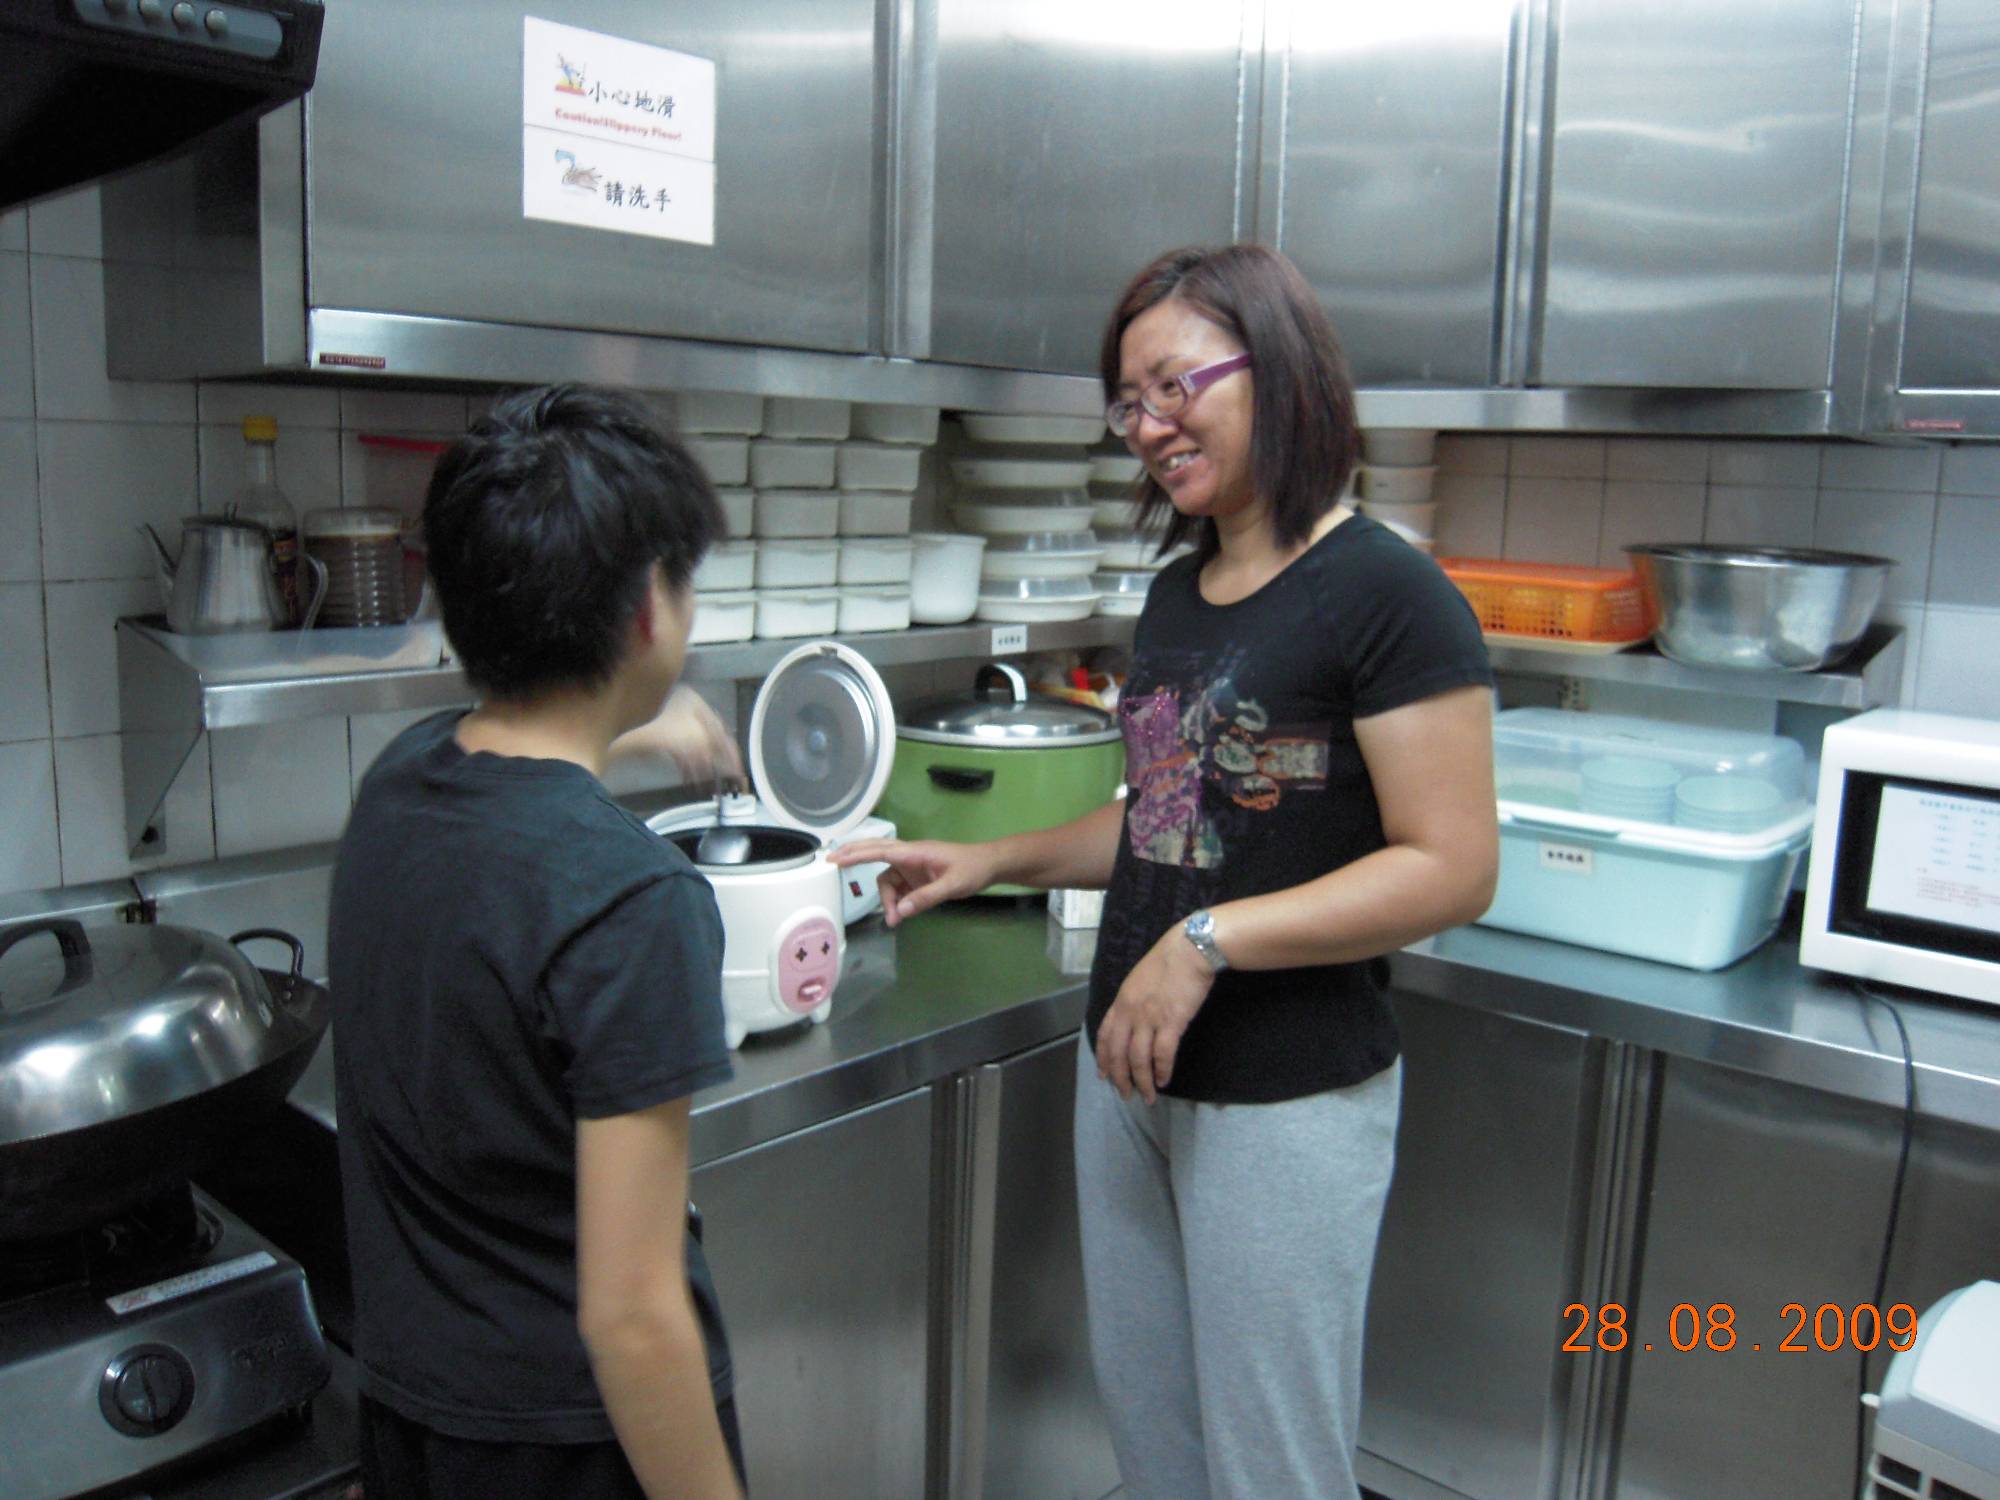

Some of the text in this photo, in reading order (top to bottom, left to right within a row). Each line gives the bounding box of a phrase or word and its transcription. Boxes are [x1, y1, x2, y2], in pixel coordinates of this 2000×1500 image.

[588, 80, 675, 118] 小心地滑
[604, 181, 671, 213] 請洗手
